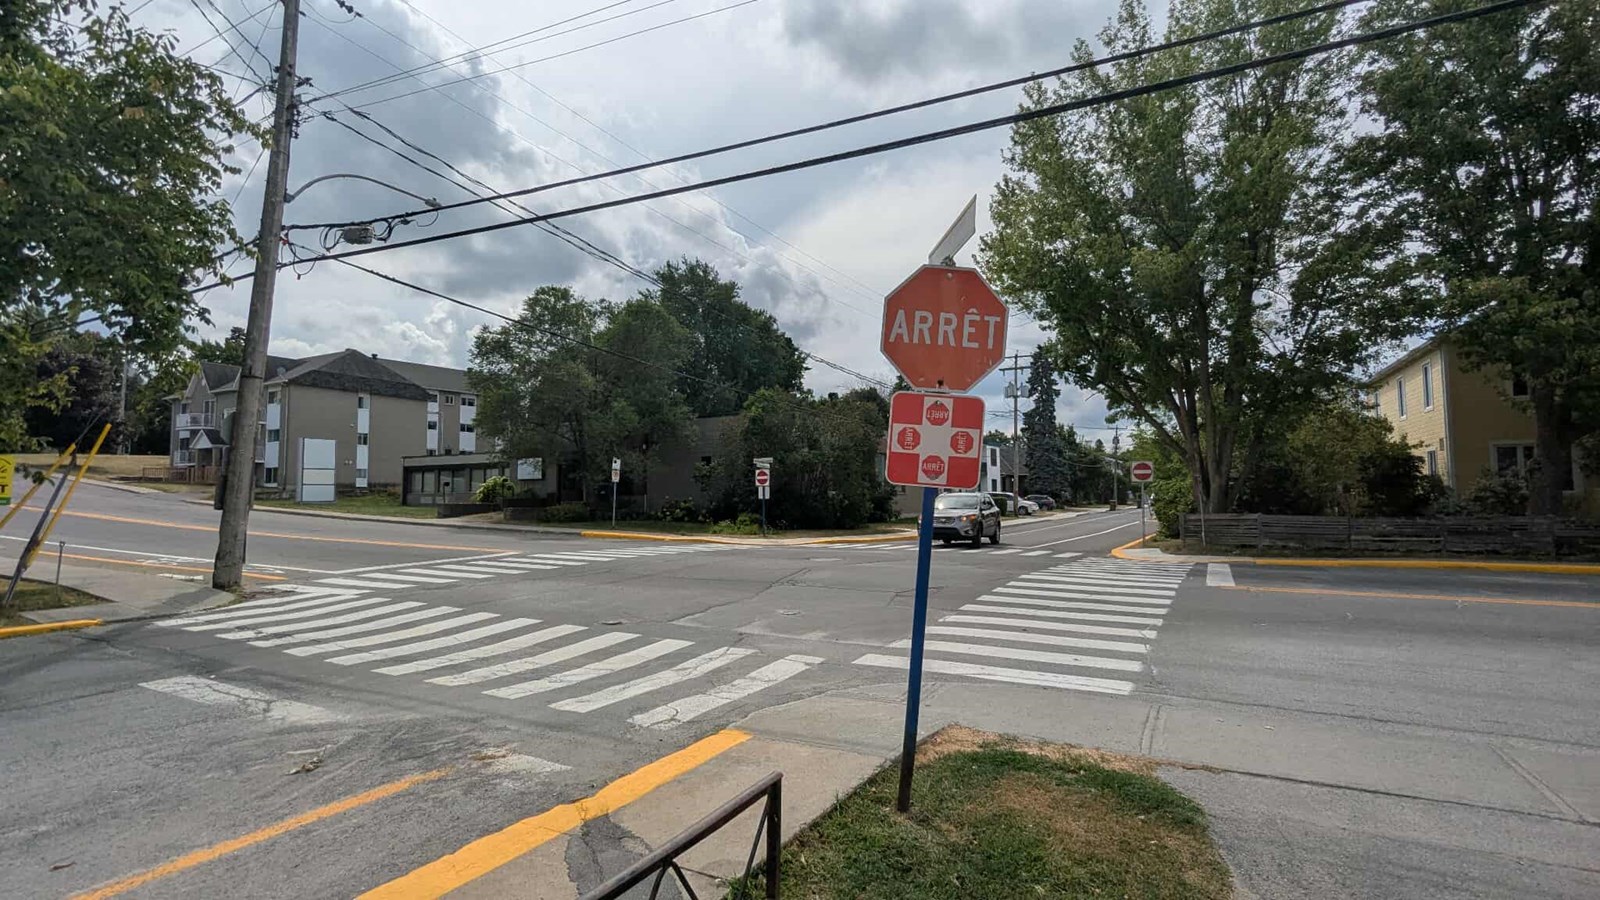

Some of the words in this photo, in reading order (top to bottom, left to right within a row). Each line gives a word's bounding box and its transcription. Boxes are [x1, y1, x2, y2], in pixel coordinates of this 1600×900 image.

[889, 308, 1001, 349] ARRÊT
[927, 409, 949, 421] ARRÊT
[904, 427, 914, 450] ARRÊT
[956, 432, 967, 454] ARRÊT
[922, 461, 944, 472] ARRÊT
